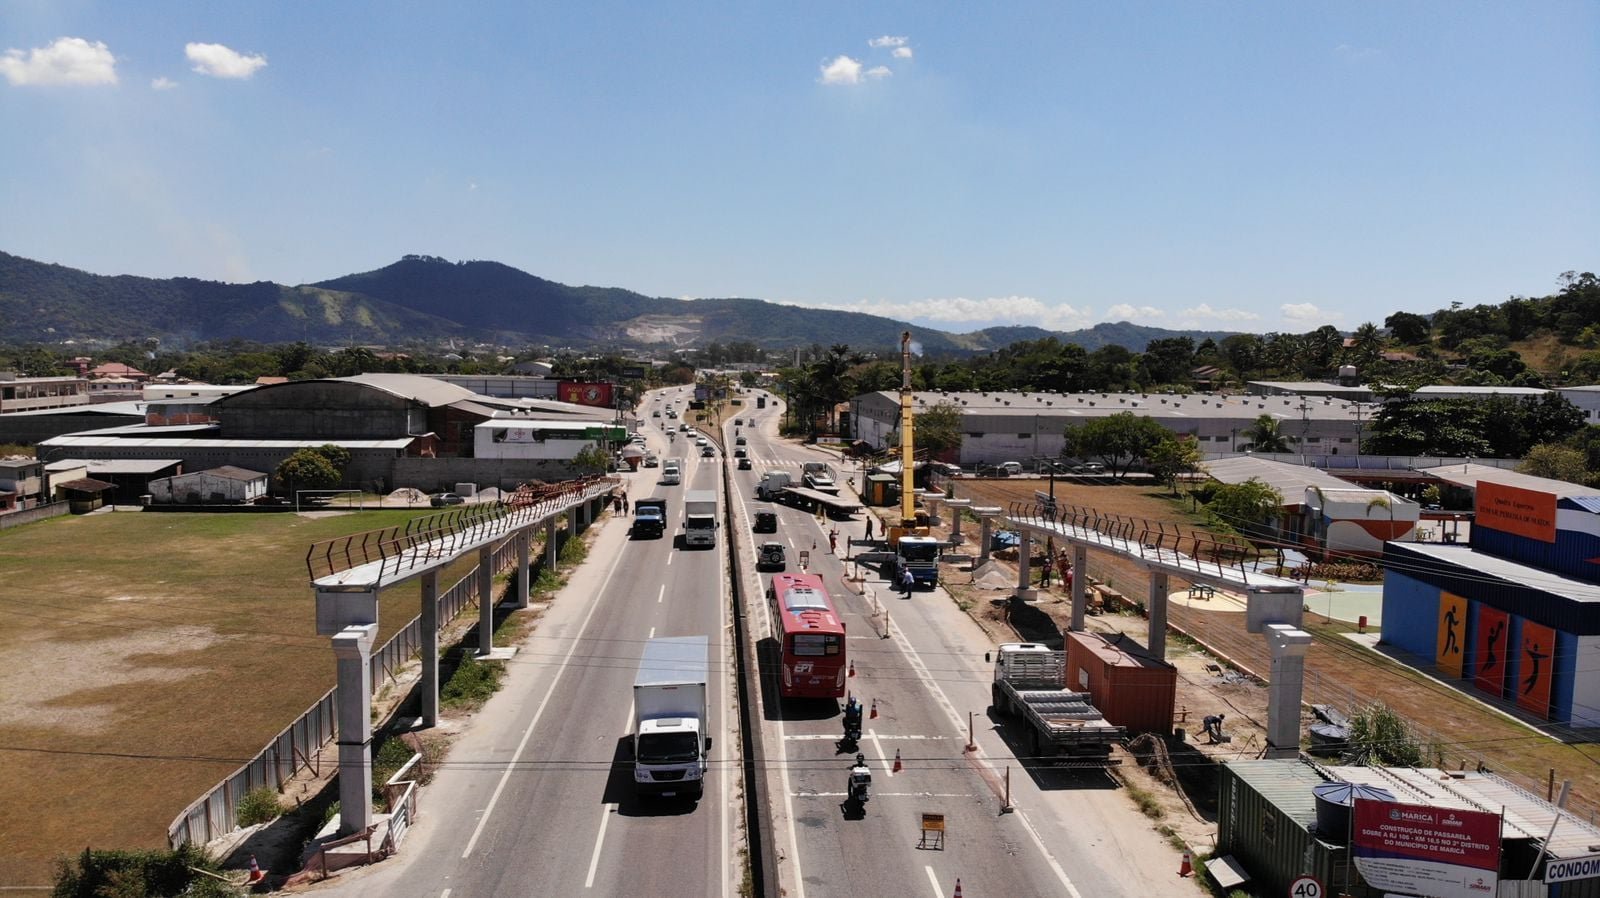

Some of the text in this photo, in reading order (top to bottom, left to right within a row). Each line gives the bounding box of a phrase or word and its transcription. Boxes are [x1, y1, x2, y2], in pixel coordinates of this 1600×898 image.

[794, 663, 814, 673] EPT
[1362, 828, 1382, 838] SOBRE
[1460, 841, 1489, 851] DISTRITO
[1433, 830, 1471, 841] PASSARELA
[1384, 838, 1394, 846] DO
[1429, 844, 1438, 852] DE
[1549, 860, 1600, 878] CONDOM
[1294, 882, 1317, 898] 40
